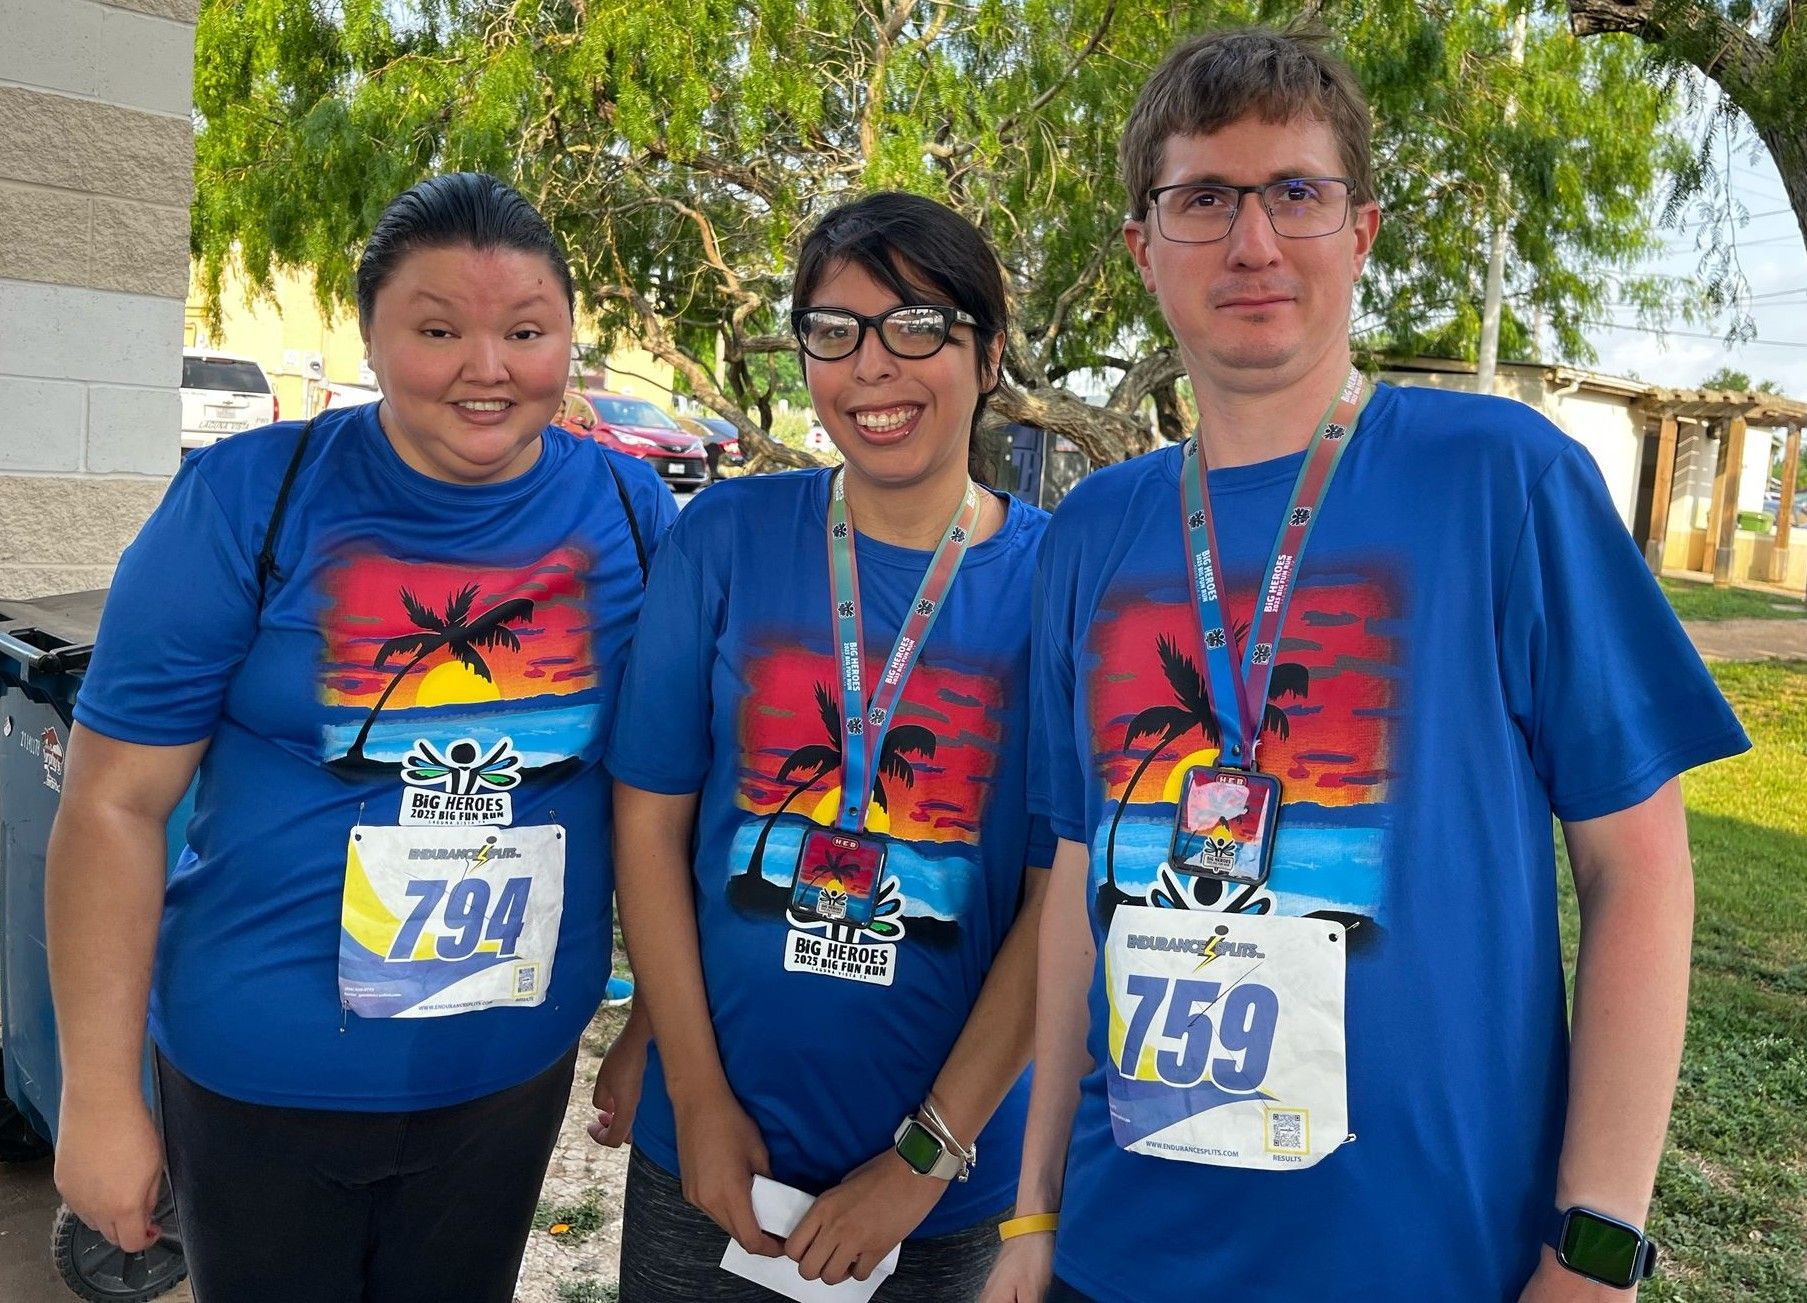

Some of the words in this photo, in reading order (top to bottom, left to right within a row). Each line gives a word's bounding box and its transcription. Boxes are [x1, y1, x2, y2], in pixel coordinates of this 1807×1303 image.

[1268, 554, 1286, 593] HEROES
[1280, 570, 1288, 584] FUN
[1284, 555, 1293, 570] RUN
[1204, 566, 1218, 601] HEROES
[891, 636, 910, 669] HEROES
[851, 658, 860, 692] HEROES
[410, 808, 436, 820] 2025
[438, 810, 456, 820] BIG
[460, 811, 478, 820] FUN
[482, 812, 504, 820] RUN
[445, 796, 503, 812] HEROES
[386, 876, 532, 962] 794
[827, 942, 888, 965] HEROES
[1127, 934, 1206, 954] ENDURANCE
[794, 954, 818, 966] 2025
[821, 958, 838, 970] BIG
[841, 962, 861, 974] FUN
[864, 965, 886, 976] RUN
[1120, 974, 1279, 1092] 759
[1146, 1140, 1239, 1158] WWW.ENDURANCESPLITS.COM
[1272, 1154, 1302, 1162] RESULTS
